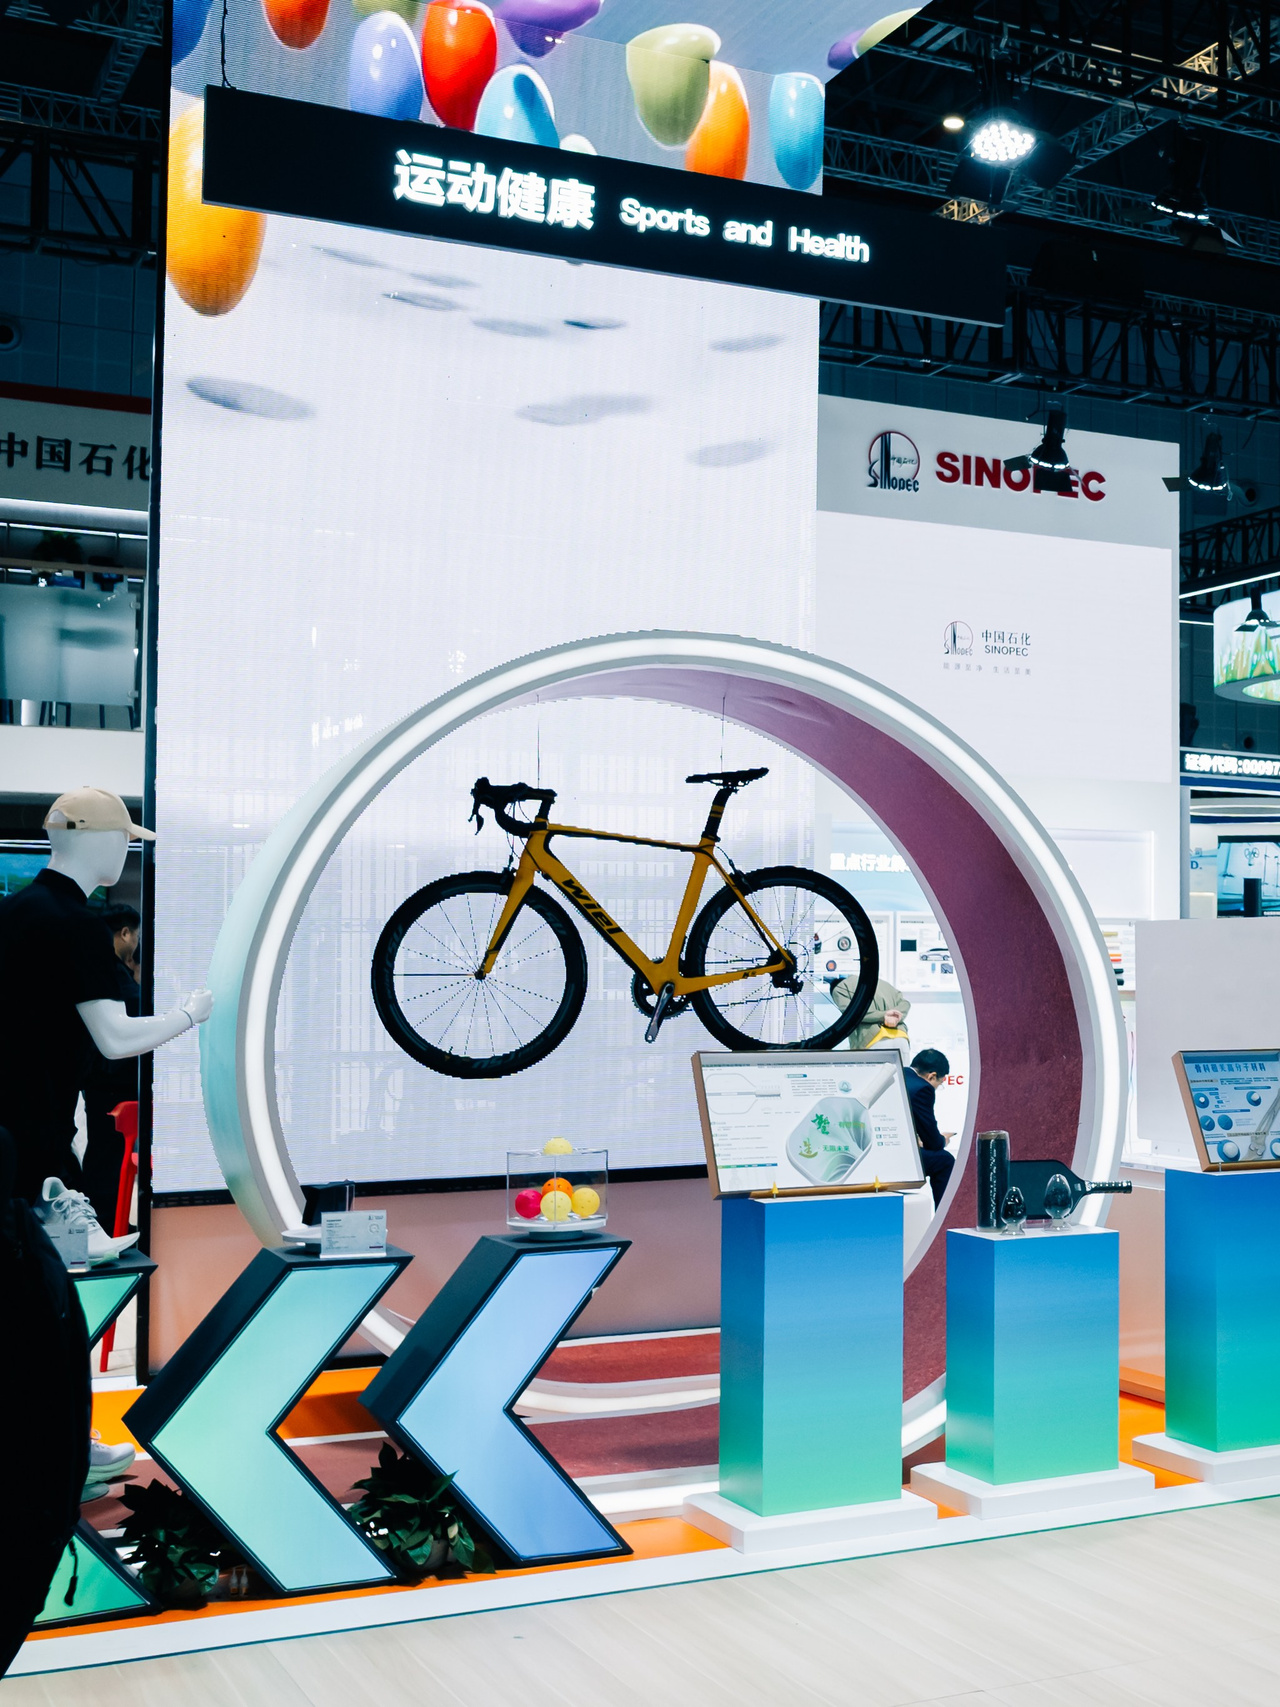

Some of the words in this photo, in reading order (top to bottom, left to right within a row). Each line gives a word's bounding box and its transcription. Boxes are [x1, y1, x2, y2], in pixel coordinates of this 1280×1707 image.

[393, 149, 596, 230] 运动健康
[619, 198, 710, 237] Sports
[723, 219, 773, 248] and
[787, 225, 871, 264] Health
[981, 629, 1031, 646] 中国石化
[984, 644, 1029, 657] SINOPEC
